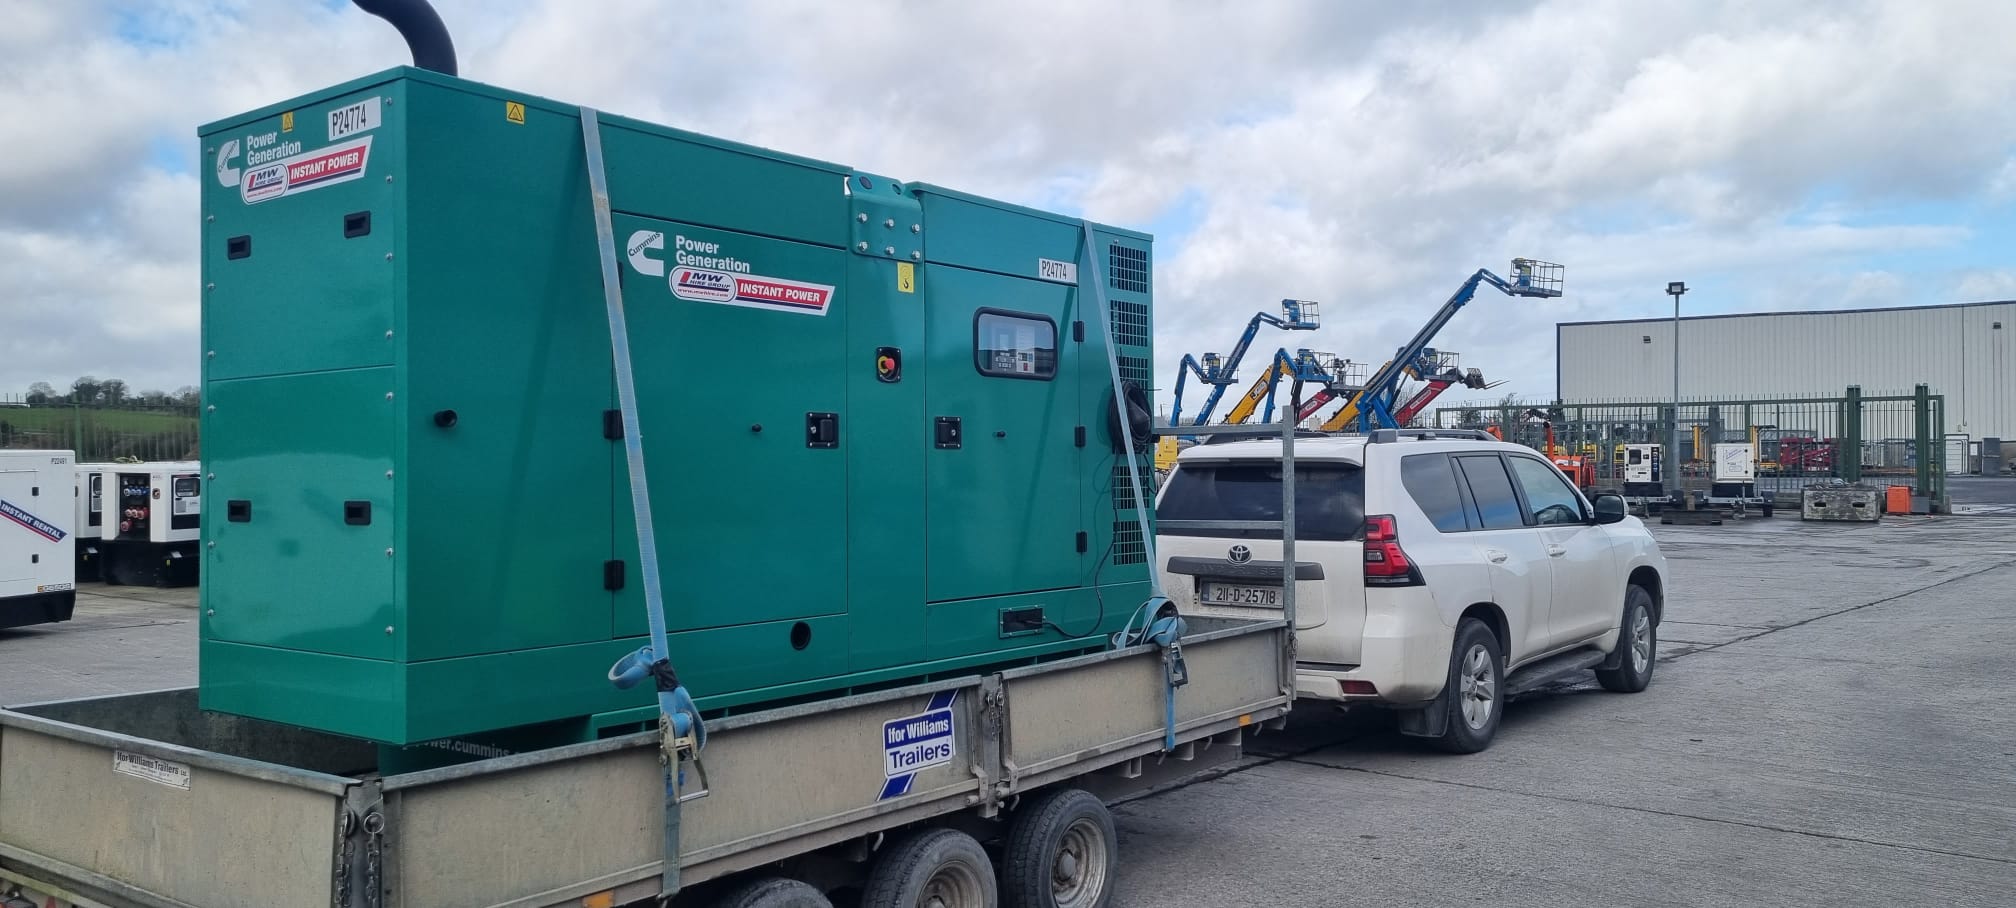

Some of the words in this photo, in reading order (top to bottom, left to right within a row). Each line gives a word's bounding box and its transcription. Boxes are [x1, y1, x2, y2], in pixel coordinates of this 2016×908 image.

[332, 104, 366, 136] P24774
[247, 132, 277, 150] Power
[247, 141, 301, 165] Generation
[256, 168, 279, 181] MW
[291, 161, 327, 179] INSTANT
[328, 152, 359, 171] POWER
[628, 232, 661, 257] Cummins
[676, 235, 720, 254] Power
[676, 250, 750, 273] Generation
[1041, 260, 1067, 280] P24774
[692, 272, 724, 283] MW
[740, 282, 783, 298] INSTANT
[785, 286, 820, 302] POWER
[1, 503, 34, 524] INSTANT
[32, 520, 61, 539] RENTAL
[1216, 587, 1276, 604] 211-D-25718
[887, 727, 906, 745] Ifor
[906, 719, 949, 740] Williams
[117, 751, 128, 761] Ifor
[129, 752, 154, 768] Williams
[155, 761, 179, 775] Trailers
[889, 743, 951, 769] Trailers
